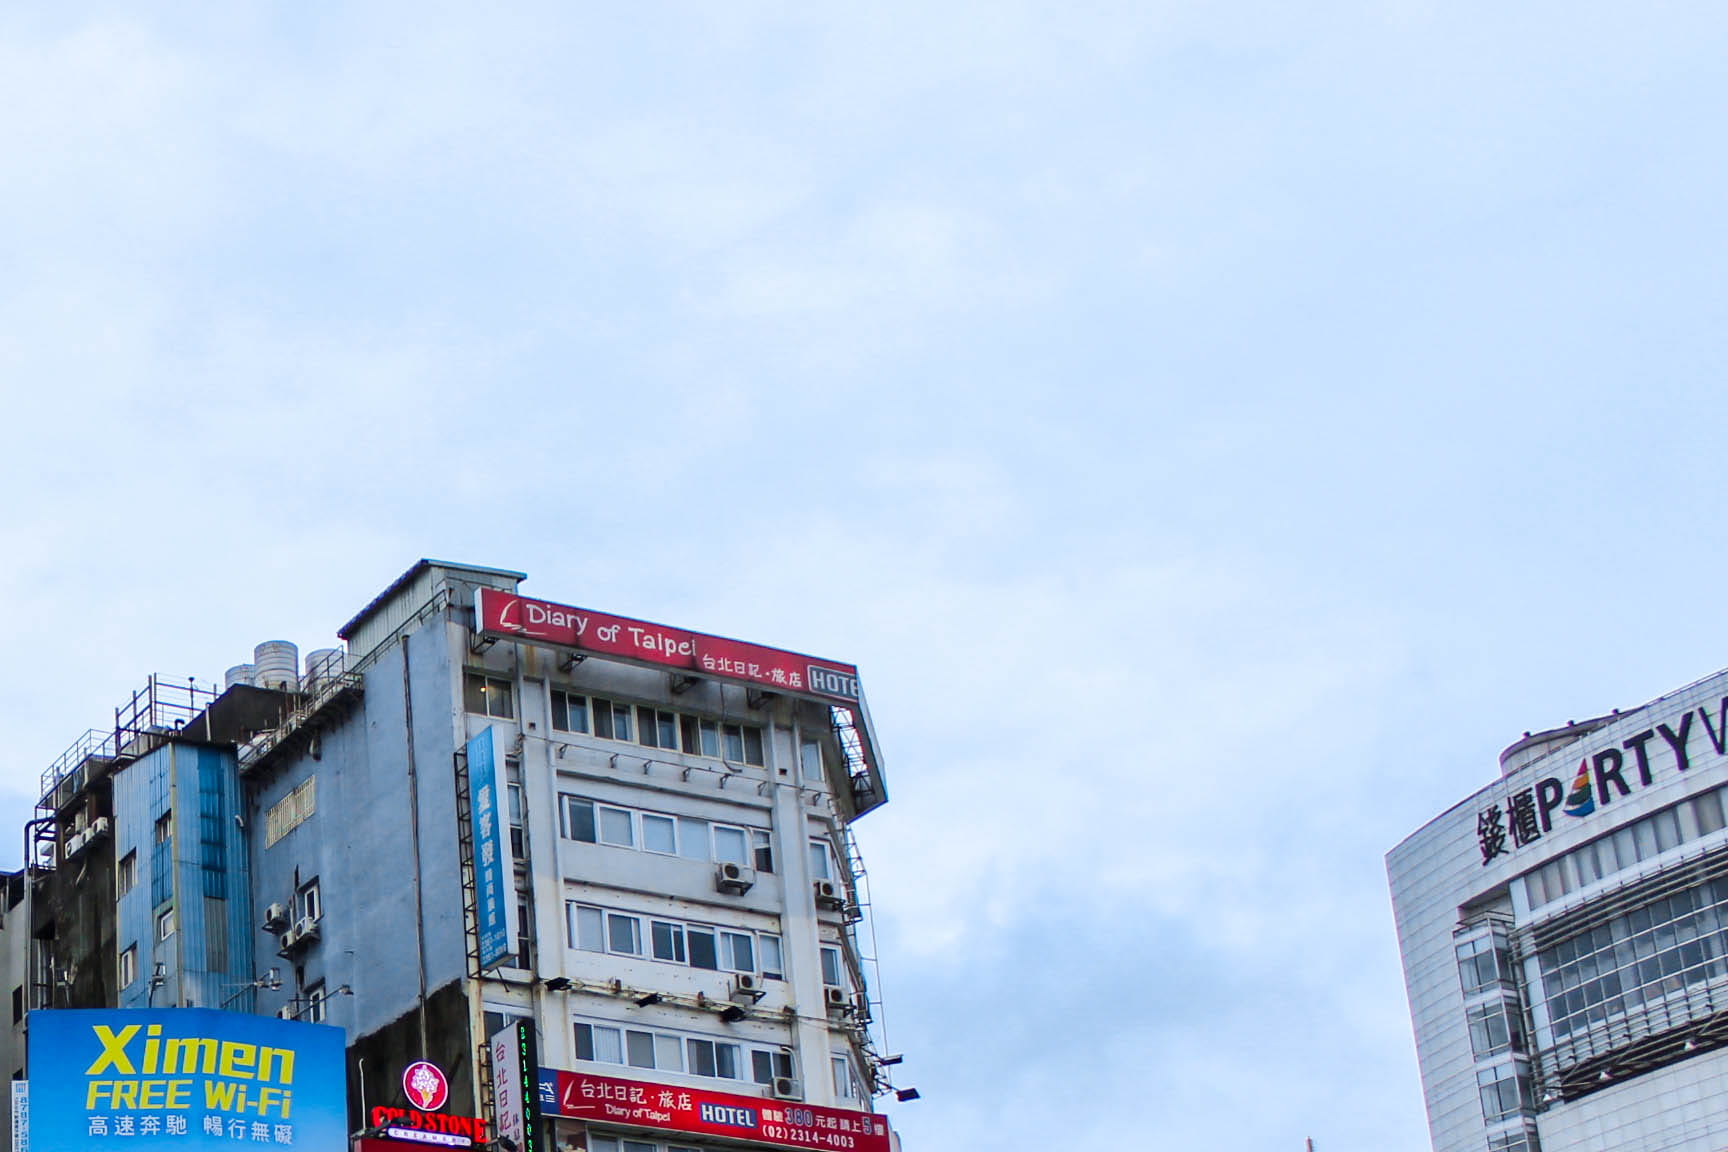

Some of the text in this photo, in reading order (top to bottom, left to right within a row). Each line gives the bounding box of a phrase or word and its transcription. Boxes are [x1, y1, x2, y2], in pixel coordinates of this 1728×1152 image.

[526, 604, 697, 657] Diary of Taipei
[85, 1023, 295, 1085] Ximen
[85, 1079, 292, 1119] FREE Wi-Fi
[605, 1103, 671, 1122] Diary of Taipei
[701, 1103, 755, 1128] HOTEL
[88, 1115, 293, 1146] 高速奔馳 暢行無礙
[373, 1105, 487, 1144] COLD STONE
[762, 1125, 855, 1149] (02)2314-4003
